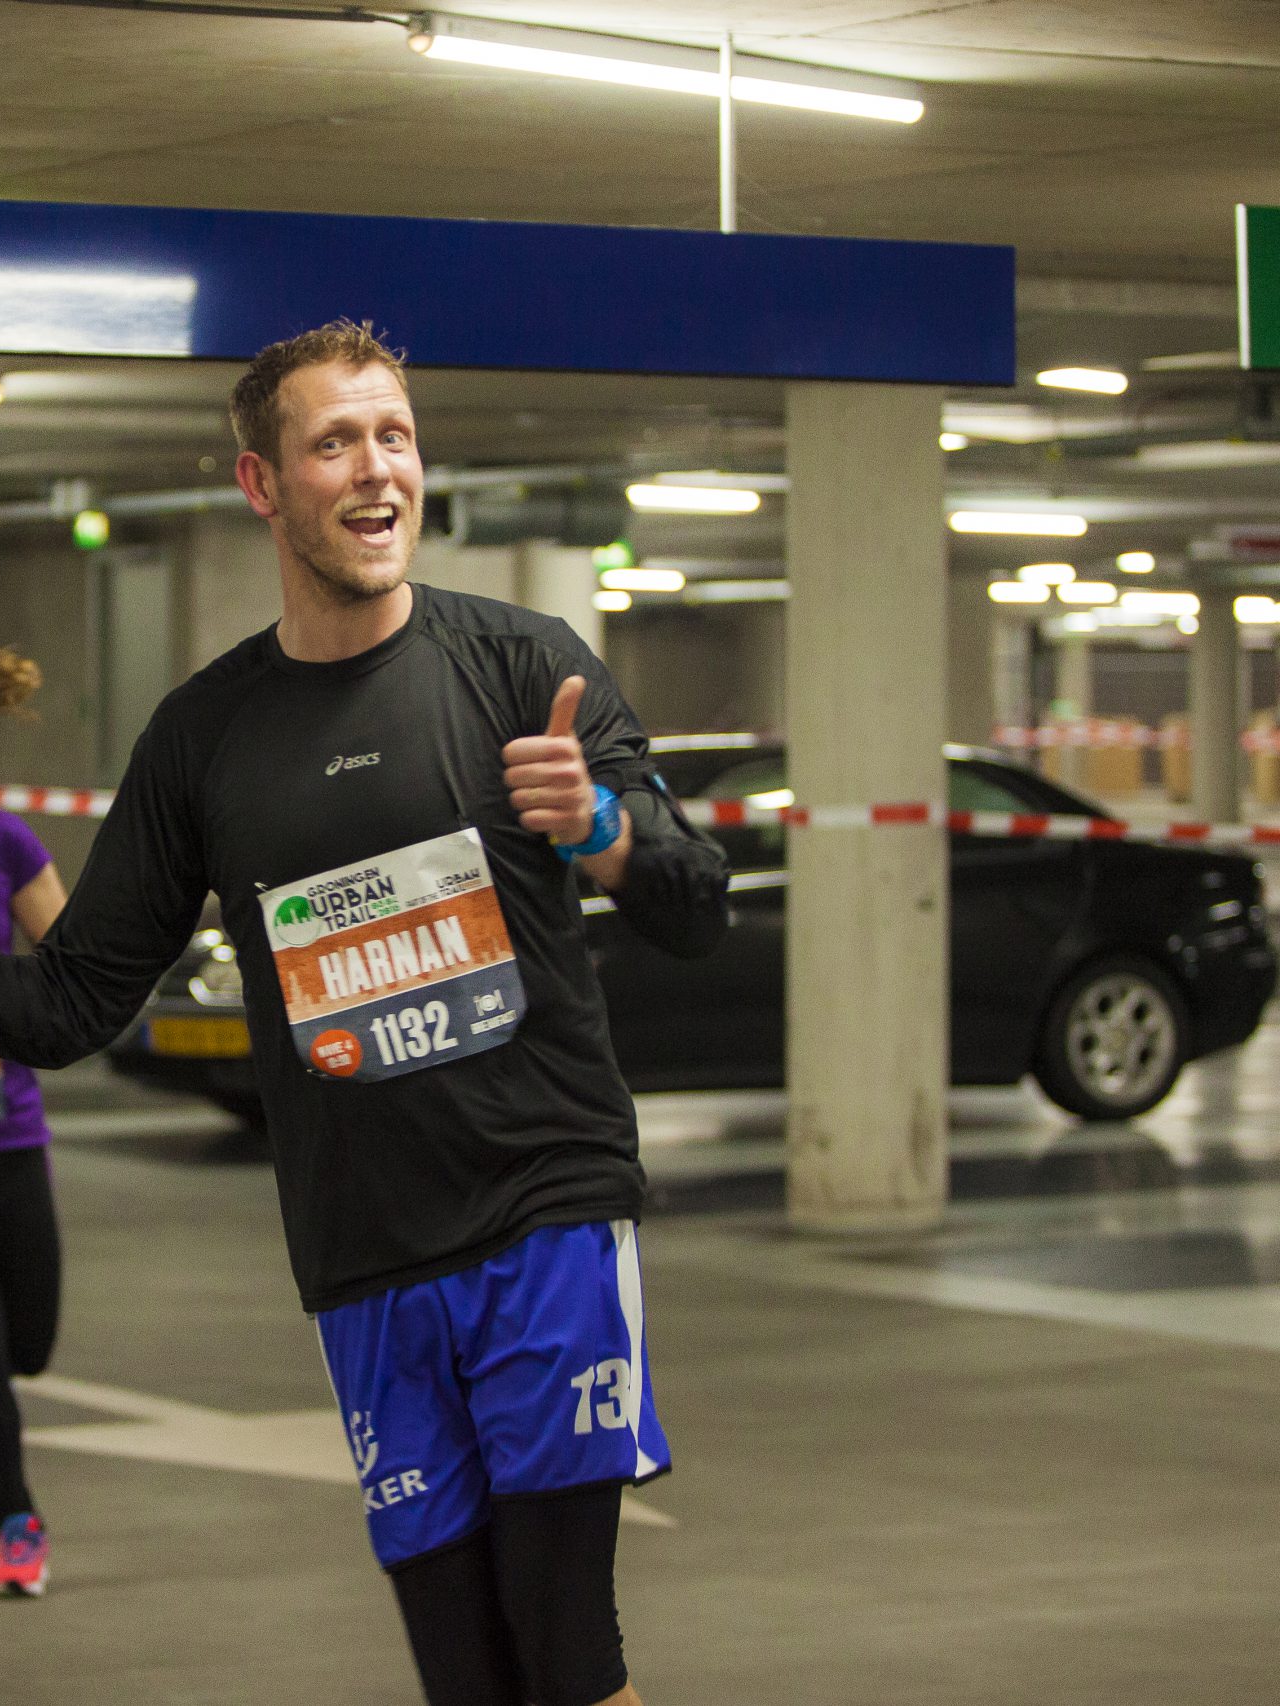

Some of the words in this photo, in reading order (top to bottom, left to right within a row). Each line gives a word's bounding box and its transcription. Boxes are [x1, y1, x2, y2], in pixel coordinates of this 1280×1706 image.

[343, 752, 381, 769] asics
[307, 867, 380, 898] GRONINGEN
[309, 874, 397, 918] URBAN
[324, 906, 377, 932] TRAIL
[318, 915, 470, 1000] HARNAN
[370, 1000, 460, 1067] 1132
[570, 1358, 631, 1436] 13
[362, 1467, 429, 1516] KER
